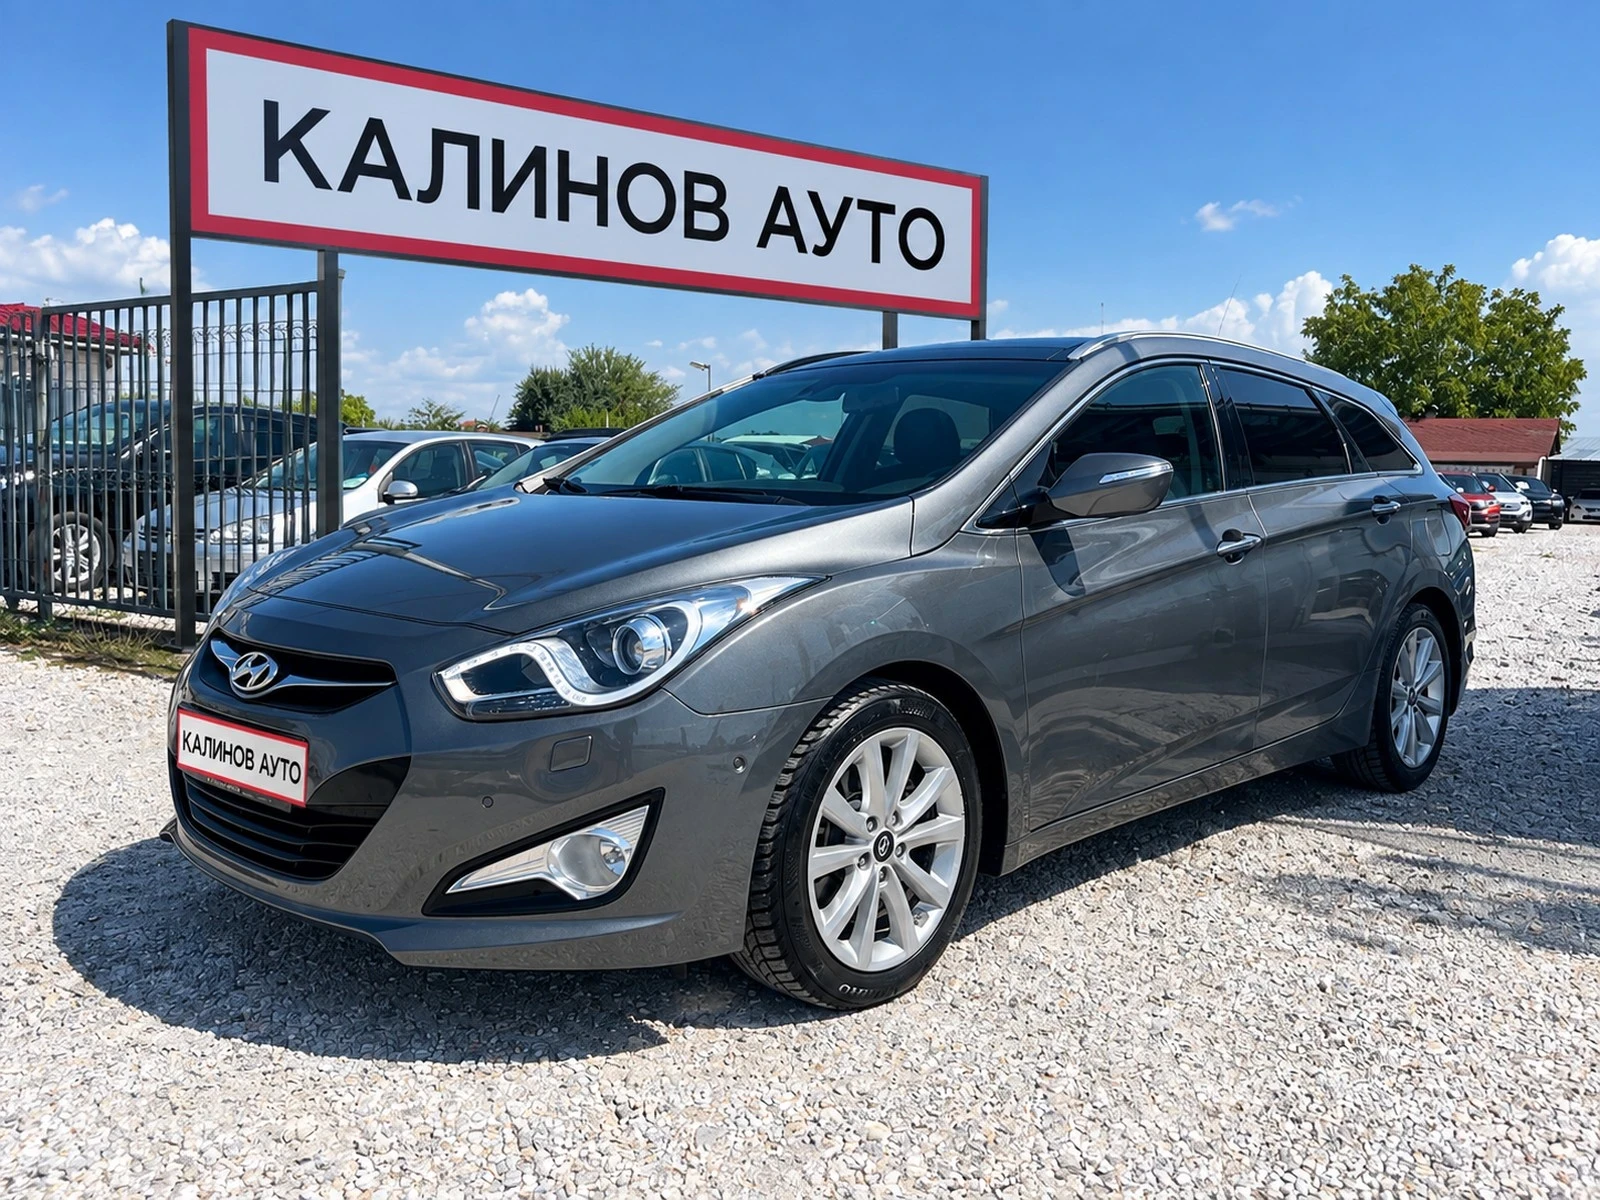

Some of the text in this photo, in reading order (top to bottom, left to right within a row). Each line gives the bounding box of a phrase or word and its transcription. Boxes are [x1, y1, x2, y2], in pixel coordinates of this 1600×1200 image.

[263, 99, 946, 271] КАЛИНОВ АУТО
[182, 729, 302, 785] КАЛИНОВ АУТО
